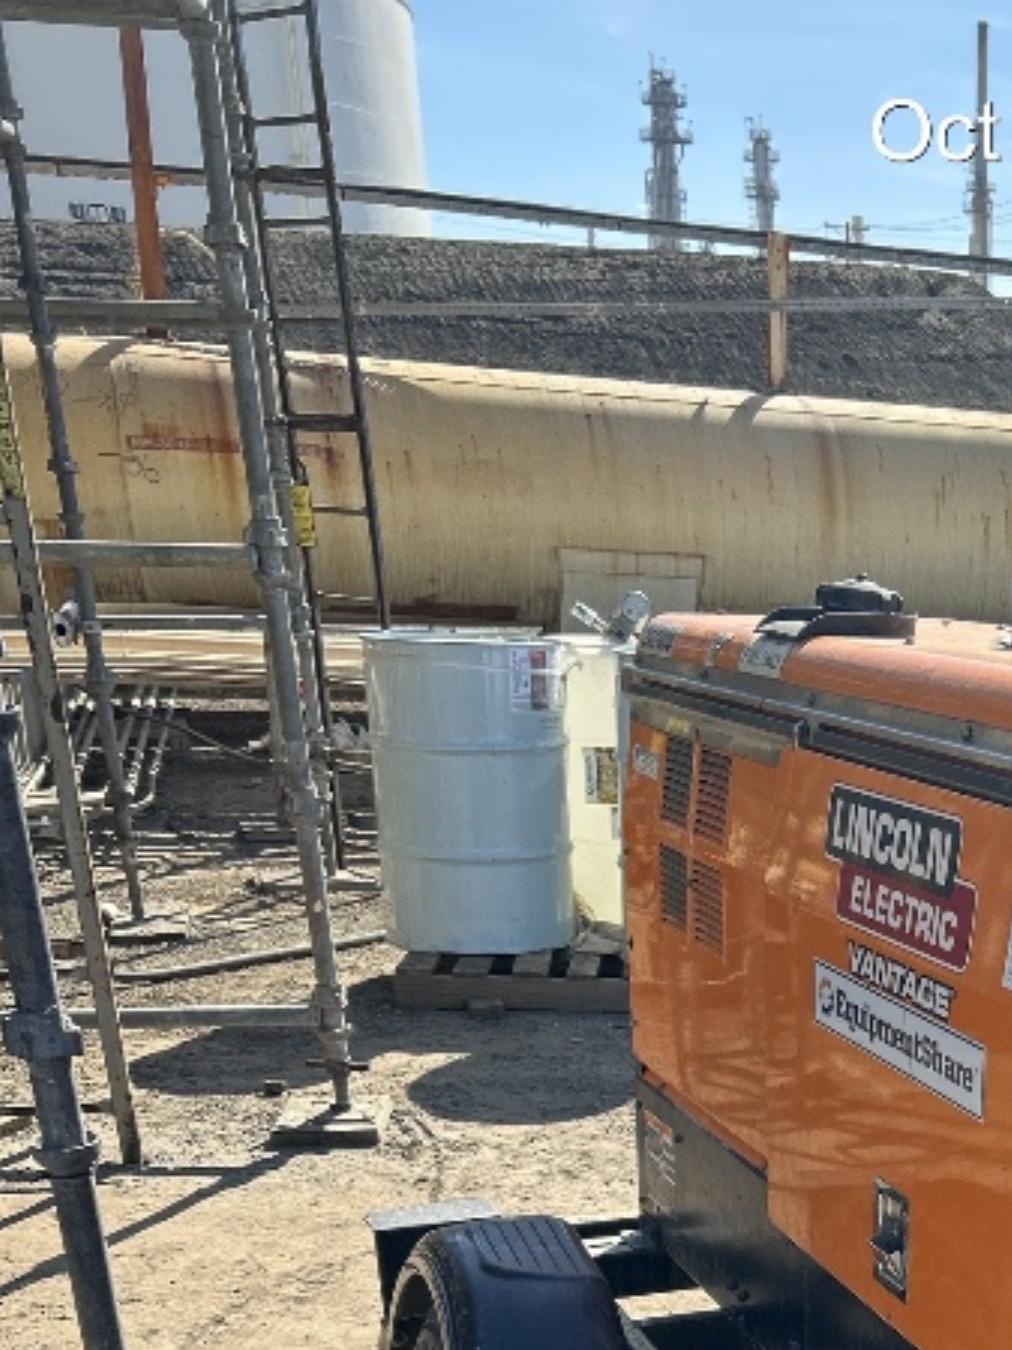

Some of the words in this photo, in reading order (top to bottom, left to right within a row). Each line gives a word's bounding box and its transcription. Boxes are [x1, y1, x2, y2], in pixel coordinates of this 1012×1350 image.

[832, 800, 953, 886] LINCOLN
[850, 875, 958, 952] ELECTRIC
[848, 939, 955, 1022] VANTAGE
[836, 988, 973, 1093] EquipmentShare
